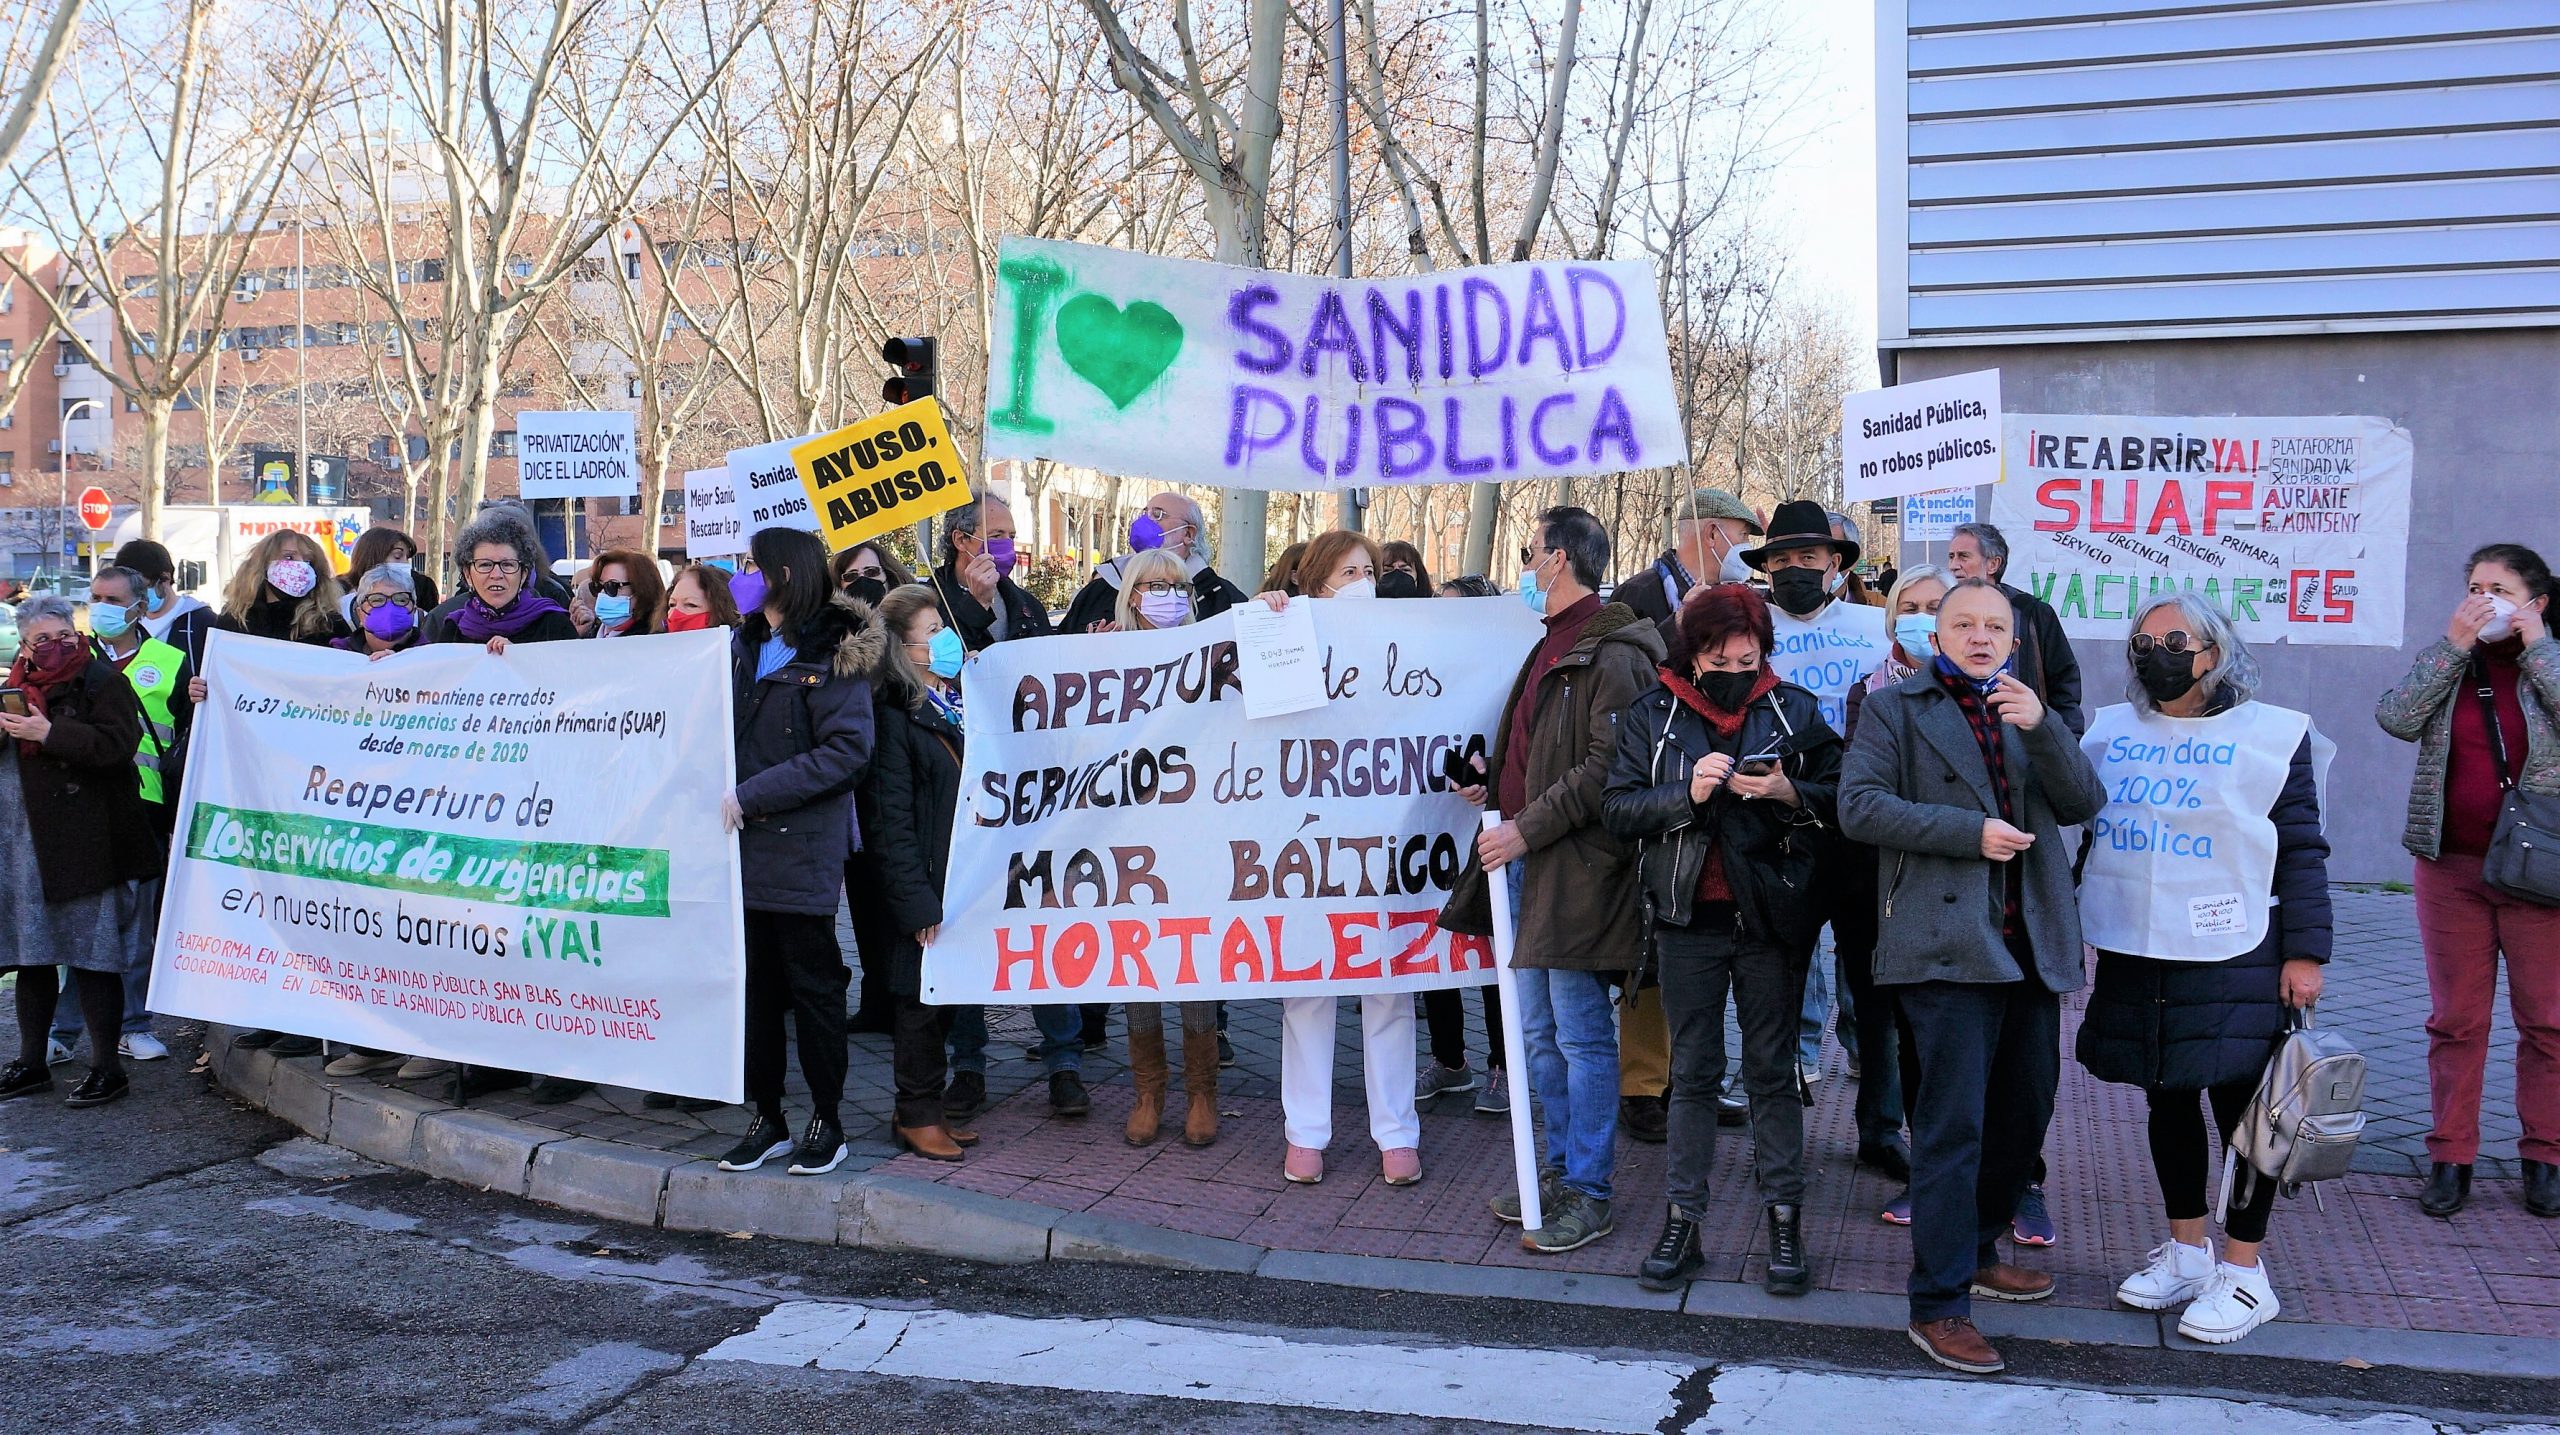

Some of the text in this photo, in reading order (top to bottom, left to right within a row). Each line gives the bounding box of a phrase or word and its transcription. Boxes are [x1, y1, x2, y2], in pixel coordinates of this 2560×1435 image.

[1225, 268, 1629, 385] SANIDAD
[1222, 383, 1643, 479] PUBLICA
[1863, 399, 1987, 439] Sanidad Pública,
[523, 430, 629, 455] "PRIVATIZACIÓN",
[811, 421, 938, 490] AYUSO,
[1860, 438, 1996, 479] no robos públicos.
[2212, 438, 2260, 478] YA!
[2271, 438, 2355, 456] PLATAFORMA
[524, 457, 630, 480] DICE EL LADRÓN.
[2271, 458, 2356, 475] SANIDAD VK
[2286, 474, 2298, 485] LO
[83, 503, 109, 514] STOP
[690, 485, 736, 512] Mejor Sanid
[753, 497, 808, 523] no robos
[827, 461, 957, 531] ABUSO.
[1906, 494, 1974, 509] Atención
[2033, 478, 2254, 537] SUAP
[239, 520, 333, 536] MUDANZAS
[690, 519, 722, 539] Rescatar
[725, 516, 731, 535] la
[2281, 511, 2362, 533] MONTSENY
[2052, 531, 2113, 565] SERVICIO
[2106, 532, 2170, 567] URGENCIA
[2163, 534, 2226, 567] ATENCIÓN
[2268, 578, 2287, 589] en
[2298, 576, 2319, 614] CENTROS
[2332, 585, 2359, 596] SALUD
[1261, 648, 1283, 661] 8.043
[1770, 626, 1874, 657] Sanidad
[1268, 657, 1301, 669] HORTALEZA
[1790, 658, 1867, 690] 100%
[366, 681, 556, 707] Ayuso mantiene cerrados
[1011, 640, 1243, 733] APERTUR
[1382, 642, 1443, 701] los
[234, 693, 256, 713] los
[257, 697, 280, 715] 37
[281, 700, 350, 726] Servicios
[353, 707, 373, 727] de
[379, 709, 458, 732] Urgencias
[462, 713, 482, 733] de
[555, 710, 617, 734] Primaria
[620, 709, 666, 740] (SUAP)
[358, 732, 529, 763] desde marzo de 2020
[2106, 735, 2237, 766] Sanidad
[974, 733, 1486, 828] SERVICIOS de URGENCI
[2112, 775, 2202, 809] 100%
[515, 781, 553, 827] de
[2093, 817, 2213, 859] Pública
[259, 824, 396, 875] servicios
[396, 835, 453, 884] de
[457, 852, 646, 903] urgencias
[1003, 845, 1169, 910] MAR
[2193, 896, 2239, 911] Sanidad
[220, 888, 265, 919] en
[274, 895, 383, 938] nuestros
[397, 898, 509, 957] barrios
[992, 907, 1496, 992] HORTALEZA
[175, 931, 251, 961] PLATAFORMA
[256, 947, 279, 965] EN
[282, 952, 333, 975] DEFENSA
[338, 961, 355, 979] DE
[357, 964, 371, 981] LA
[374, 966, 428, 990] SANIDAD
[494, 981, 521, 1001] SAN
[525, 984, 562, 1007] BLAS
[570, 993, 661, 1020] CANILLEJAS
[174, 954, 267, 985] COORDINADORA
[282, 975, 304, 991] EN
[310, 980, 364, 1003] DEFENSA
[371, 988, 388, 1005] DE
[392, 992, 408, 1009] LA
[410, 994, 466, 1019] SANIDAD
[535, 1012, 597, 1036] CIUDAD
[602, 1019, 656, 1041] LINEAL
